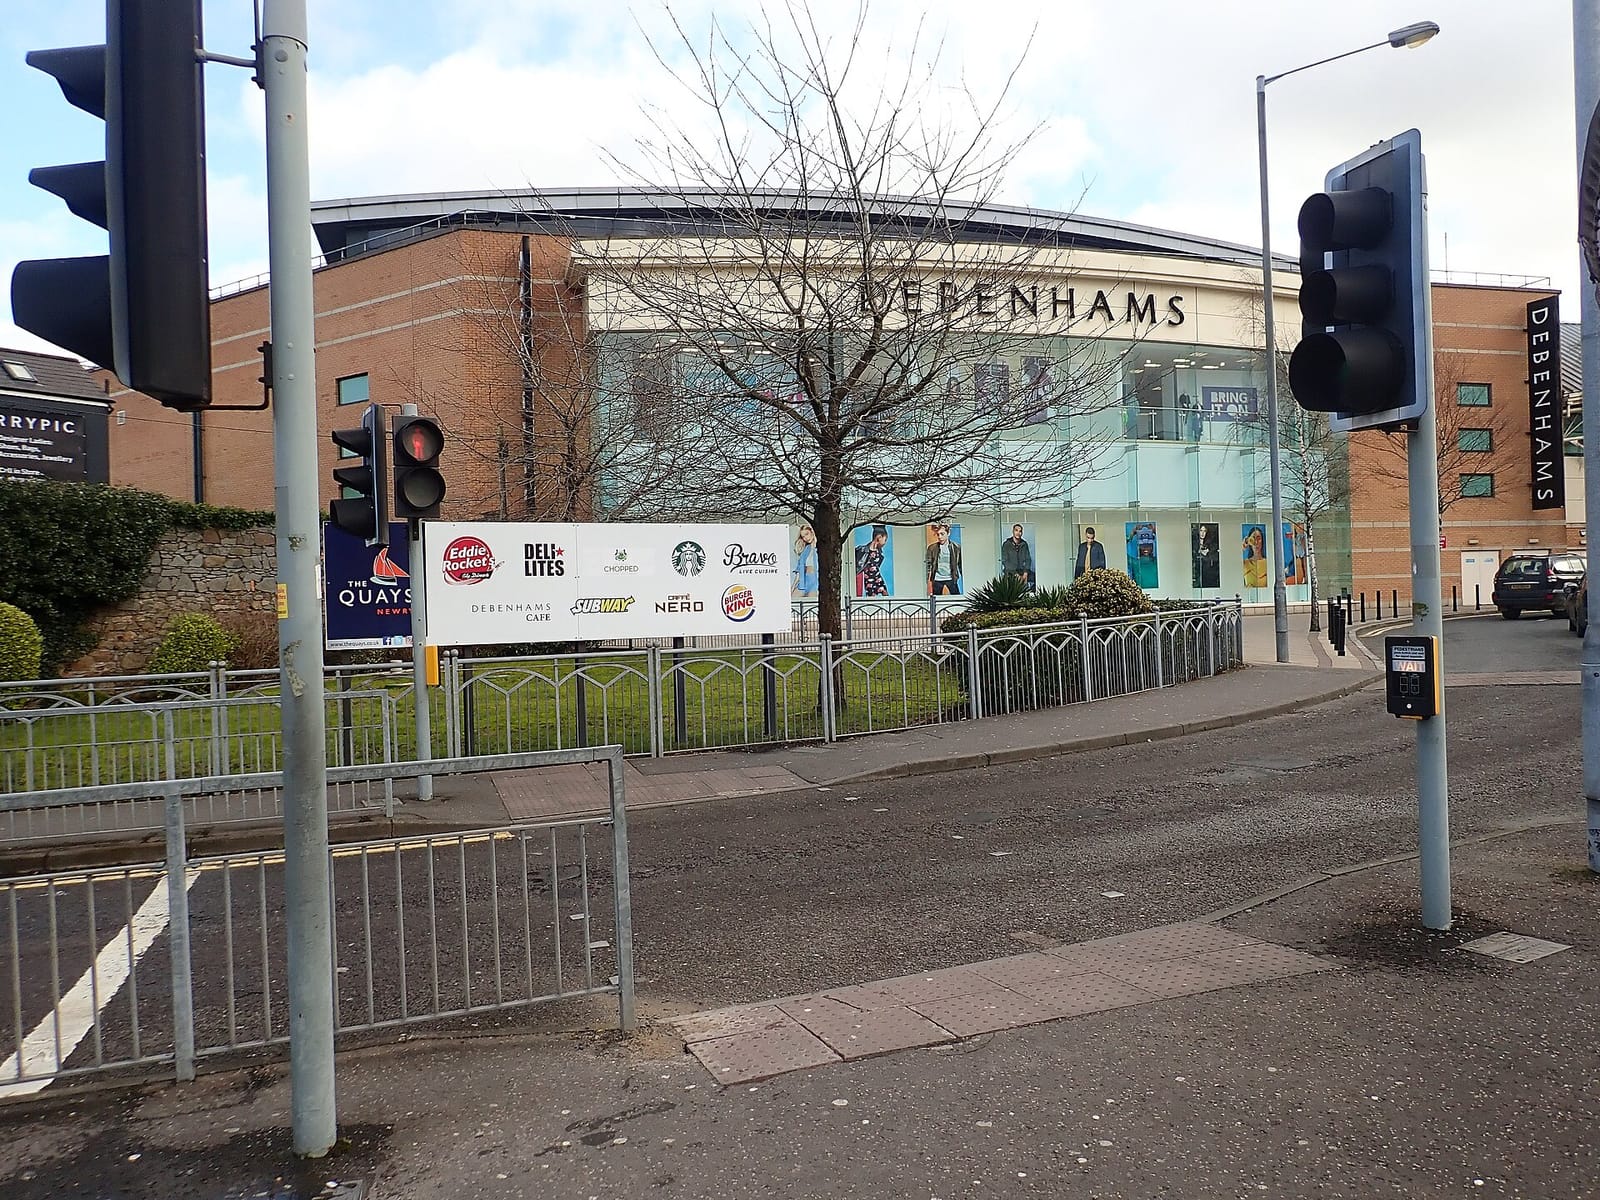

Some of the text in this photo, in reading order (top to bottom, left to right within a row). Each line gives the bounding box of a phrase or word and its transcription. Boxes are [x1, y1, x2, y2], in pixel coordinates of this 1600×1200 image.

[861, 280, 1184, 326] DEBENHAMS
[1210, 391, 1248, 404] BRING
[1531, 306, 1554, 500] DEBENHAMS
[1211, 404, 1249, 417] IT ON
[450, 545, 486, 559] Eddie
[524, 543, 556, 560] DELI
[723, 543, 778, 567] Bravo
[442, 554, 496, 572] Rocket's
[524, 560, 565, 577] LITES
[603, 565, 639, 573] CHOPPED
[347, 580, 368, 588] THE
[338, 588, 412, 607] QUAYS
[570, 596, 636, 615] SUBWAY
[724, 589, 753, 606] BURGER
[726, 596, 754, 615] KING
[471, 602, 551, 613] DEBENHAMS
[655, 601, 704, 613] NERO
[525, 613, 552, 622] CAFE
